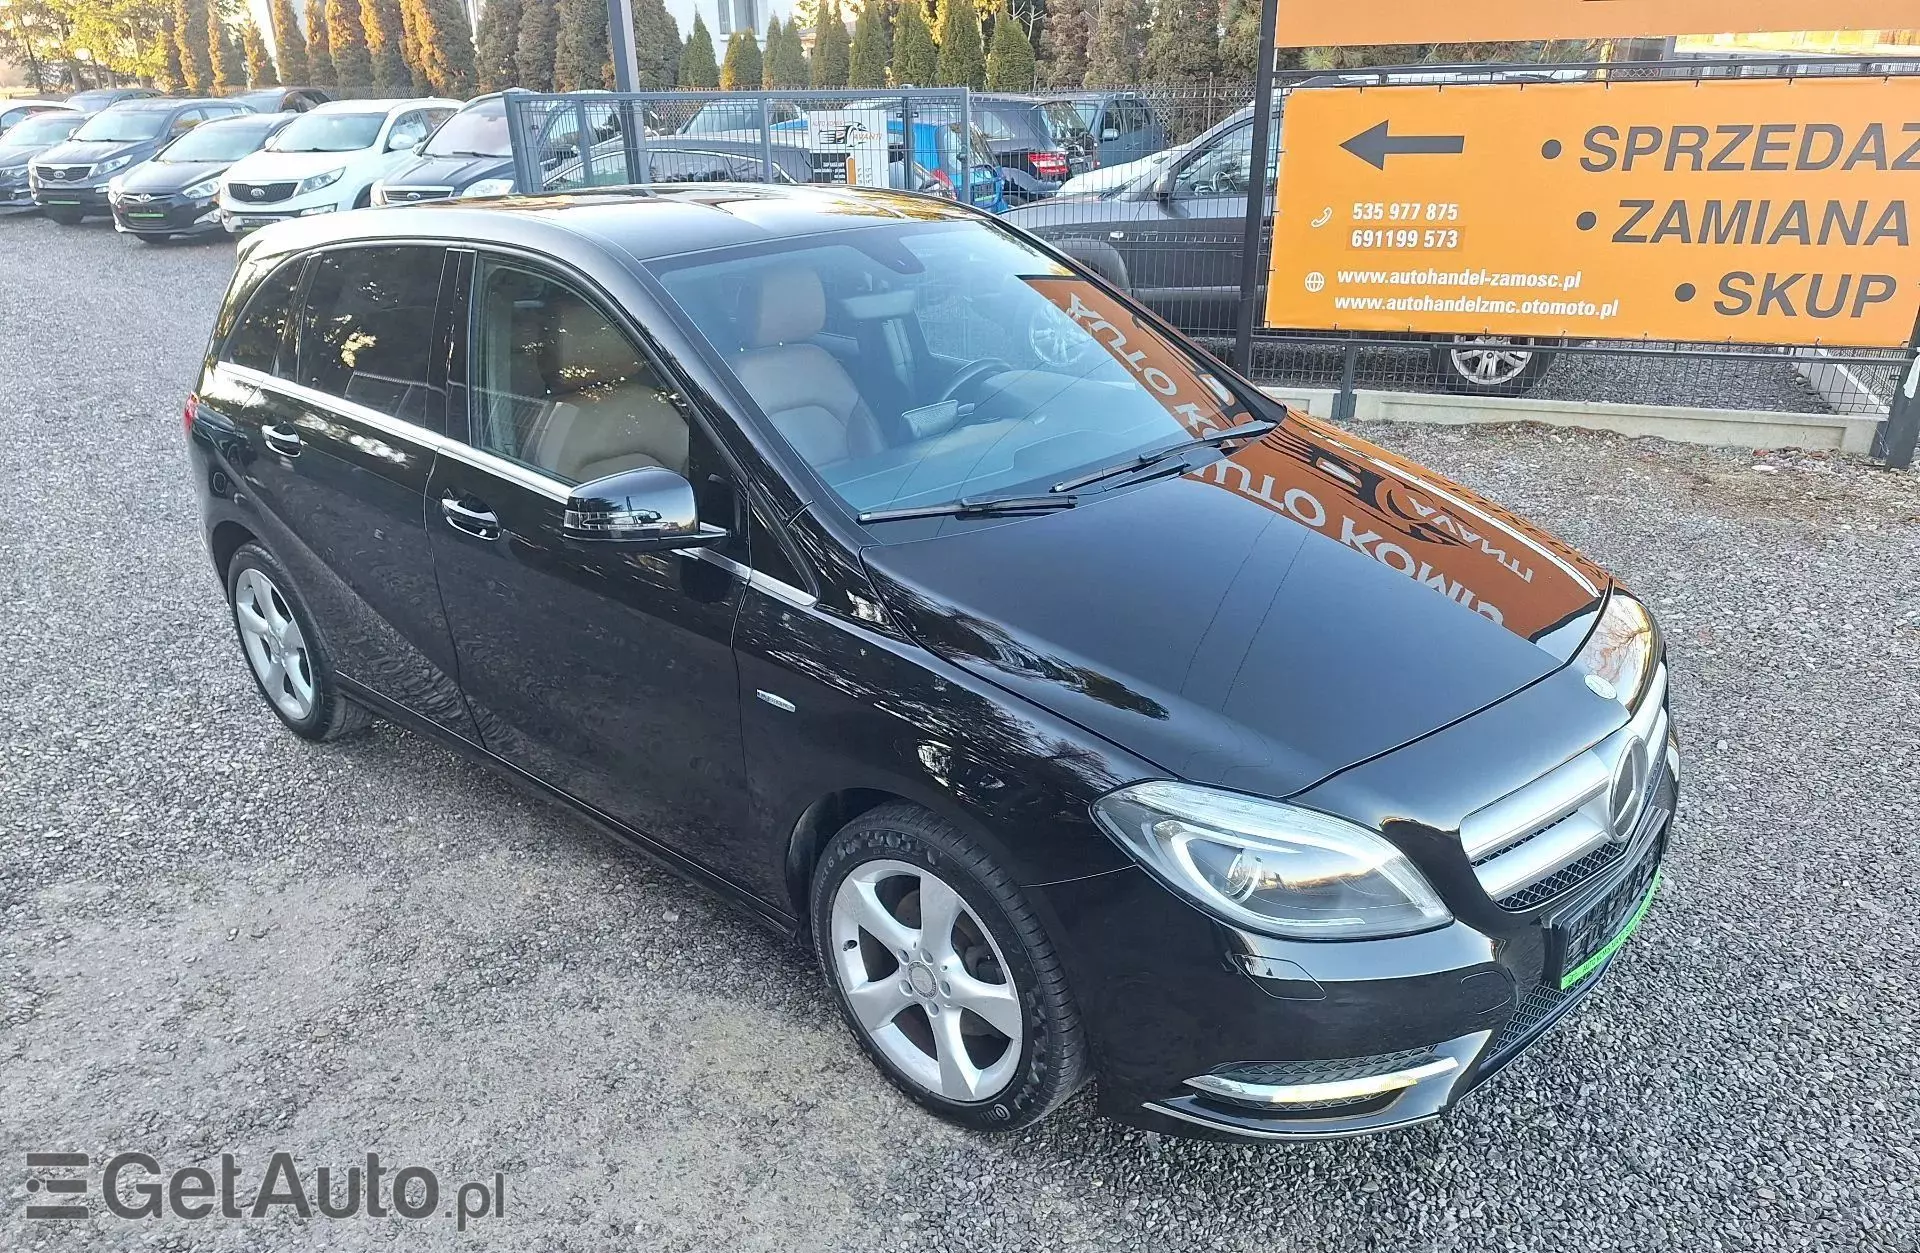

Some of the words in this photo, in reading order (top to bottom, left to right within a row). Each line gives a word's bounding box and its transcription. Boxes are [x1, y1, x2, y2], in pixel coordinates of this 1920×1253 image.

[1352, 202, 1384, 220] 535
[1389, 202, 1421, 220] 977
[1425, 202, 1459, 220] 875
[1611, 199, 1910, 247] ZAMIANA
[1423, 229, 1458, 248] 573
[1337, 268, 1582, 291] www.autohandel-zamosc.pl
[1334, 294, 1619, 319] www.autohandelzmc.otomoto.pl
[1713, 270, 1897, 319] SKUP
